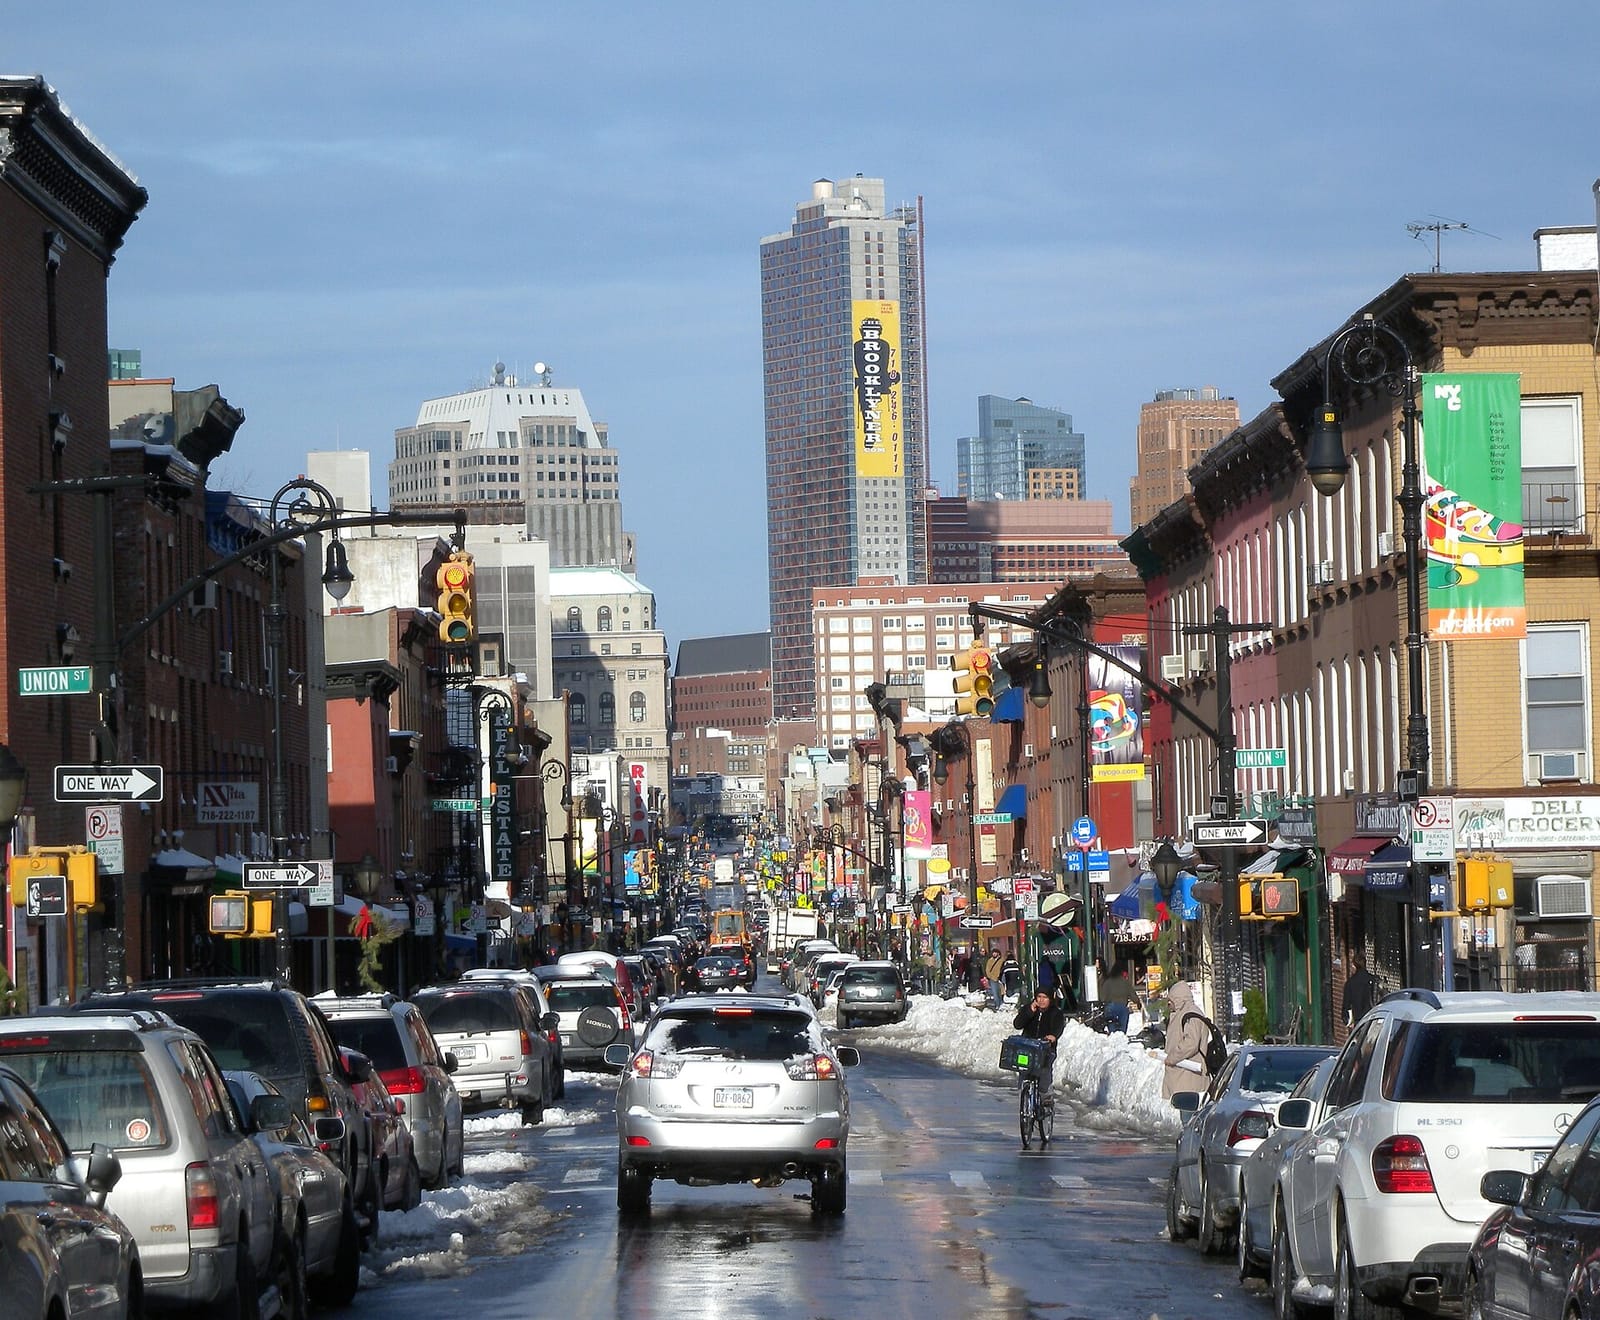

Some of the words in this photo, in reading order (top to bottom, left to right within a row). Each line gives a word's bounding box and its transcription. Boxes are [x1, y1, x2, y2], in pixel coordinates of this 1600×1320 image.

[863, 329, 882, 443] BROOKLYNER
[23, 671, 69, 691] UNION
[74, 670, 85, 680] ST
[494, 713, 511, 774] REAL
[1240, 751, 1272, 766] UNION
[1275, 751, 1283, 759] ST
[67, 777, 95, 790] ONE
[101, 777, 130, 790] WAY
[433, 801, 467, 810] SACKETT
[1532, 800, 1582, 815] DELI
[201, 810, 256, 820] 718-222-1187
[496, 784, 512, 877] ESTATE
[1201, 829, 1222, 838] ONE
[1224, 828, 1245, 837] WAY
[254, 871, 276, 880] ONE
[286, 871, 308, 880] WAY
[586, 1019, 612, 1029] HONDA
[1417, 1118, 1433, 1126] ML
[1436, 1118, 1463, 1126] 350
[150, 1224, 177, 1232] TOYOTA
